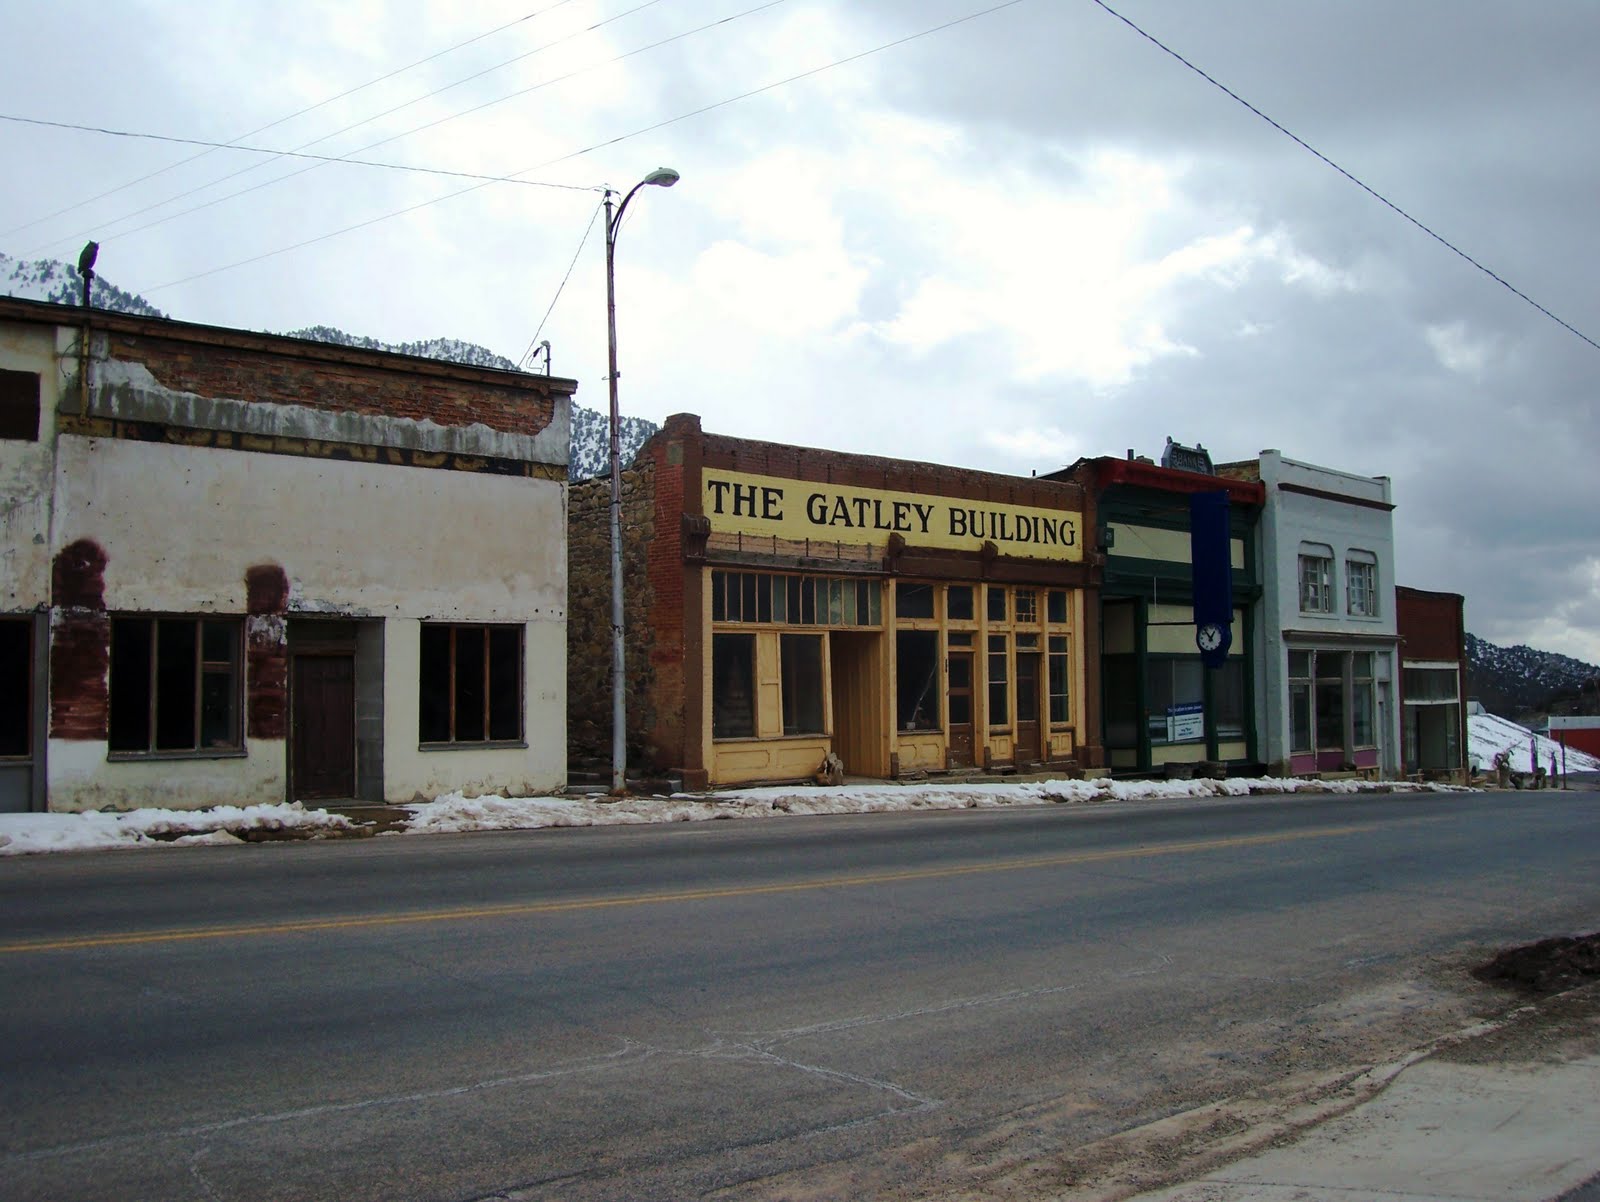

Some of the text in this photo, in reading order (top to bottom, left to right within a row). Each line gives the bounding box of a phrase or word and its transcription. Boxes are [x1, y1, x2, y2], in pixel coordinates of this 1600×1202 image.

[707, 479, 1076, 547] THE GATLEY BUILDING
